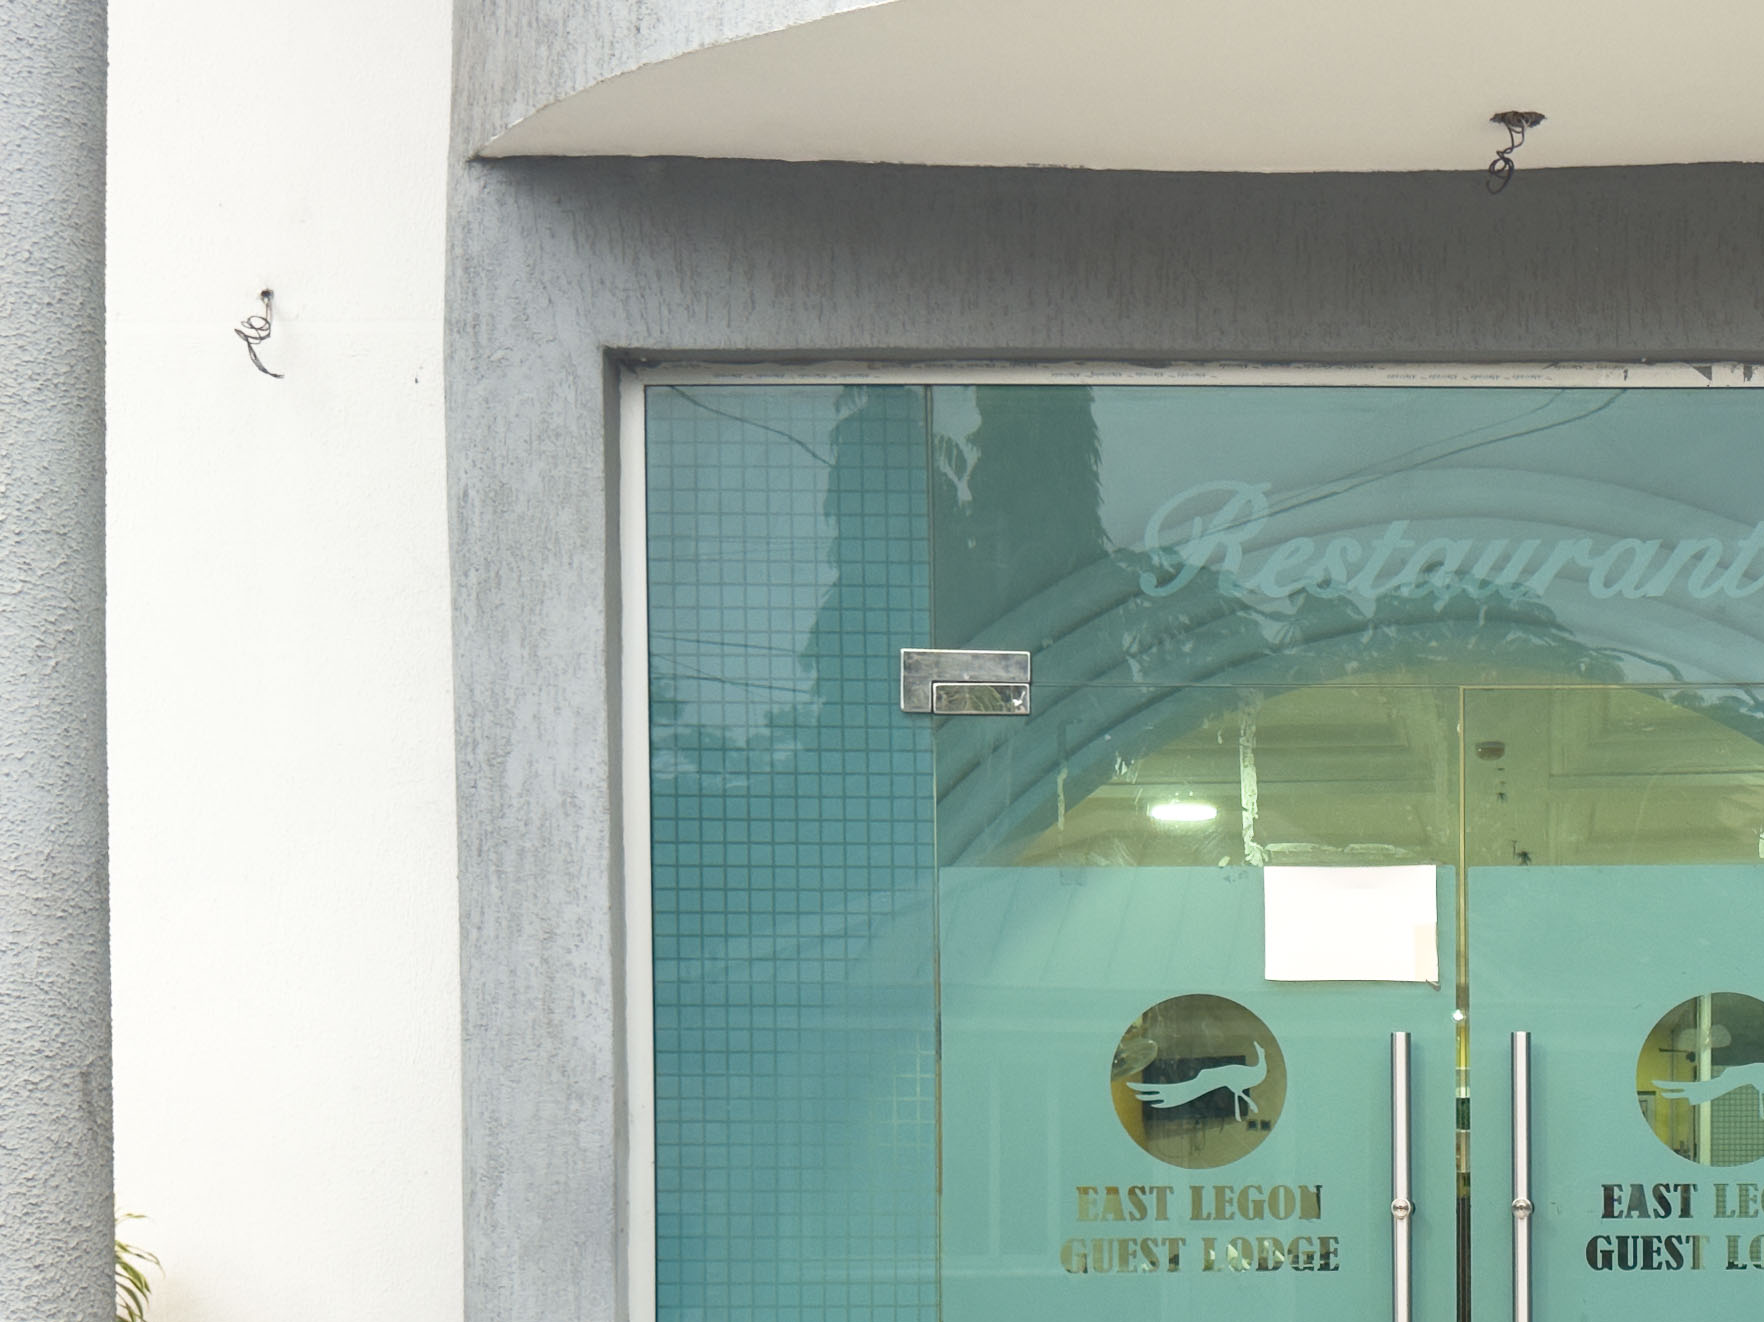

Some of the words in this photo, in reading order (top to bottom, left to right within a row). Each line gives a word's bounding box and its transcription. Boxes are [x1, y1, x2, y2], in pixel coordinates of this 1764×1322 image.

[1076, 1185, 1174, 1221] EAST
[1189, 1184, 1322, 1220] LEGON
[1601, 1183, 1697, 1219] EAST
[1060, 1236, 1186, 1274] GUEST
[1202, 1236, 1340, 1272] LODGE
[1586, 1234, 1710, 1271] GUEST
